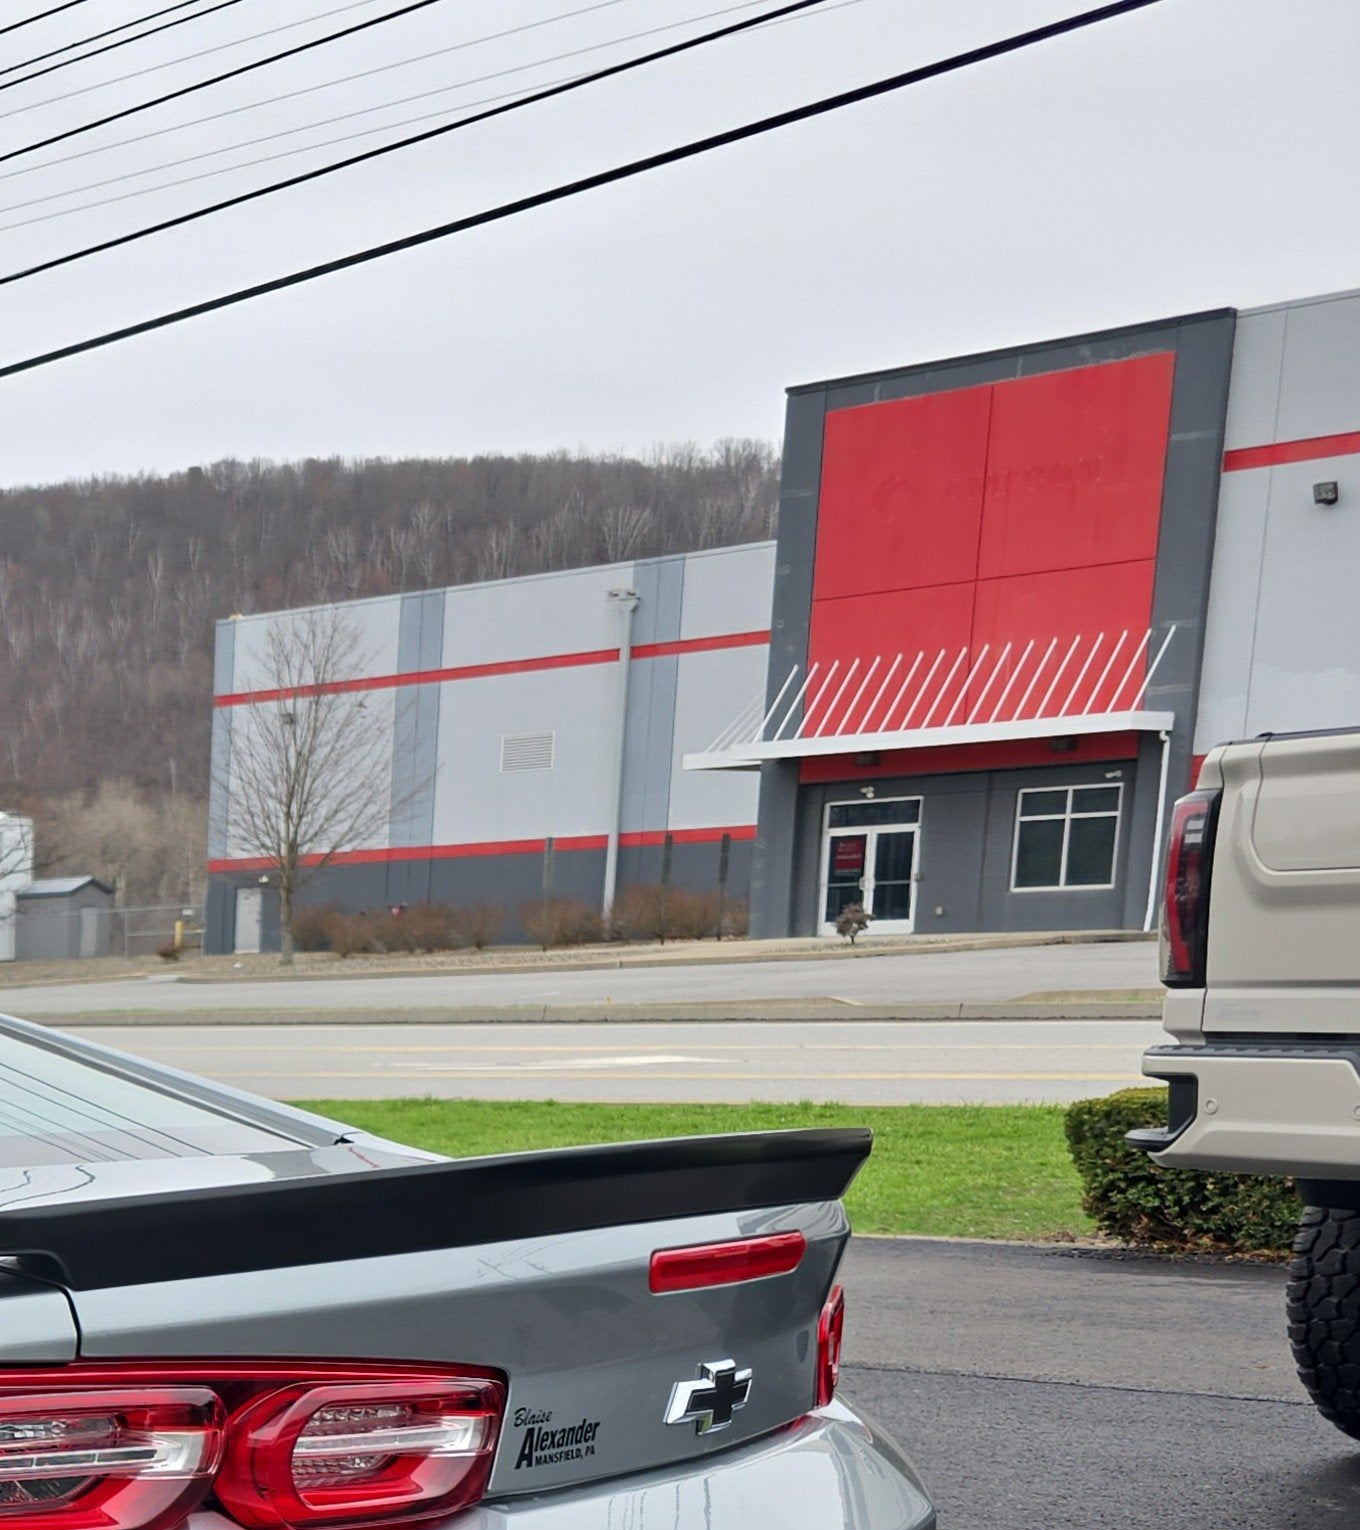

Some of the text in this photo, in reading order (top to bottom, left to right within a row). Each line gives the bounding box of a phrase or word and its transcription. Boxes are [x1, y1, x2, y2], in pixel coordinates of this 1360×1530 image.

[513, 1407, 553, 1428] Blaise
[514, 1418, 601, 1470] Alexander
[535, 1445, 596, 1466] MANSFIELD, PA
